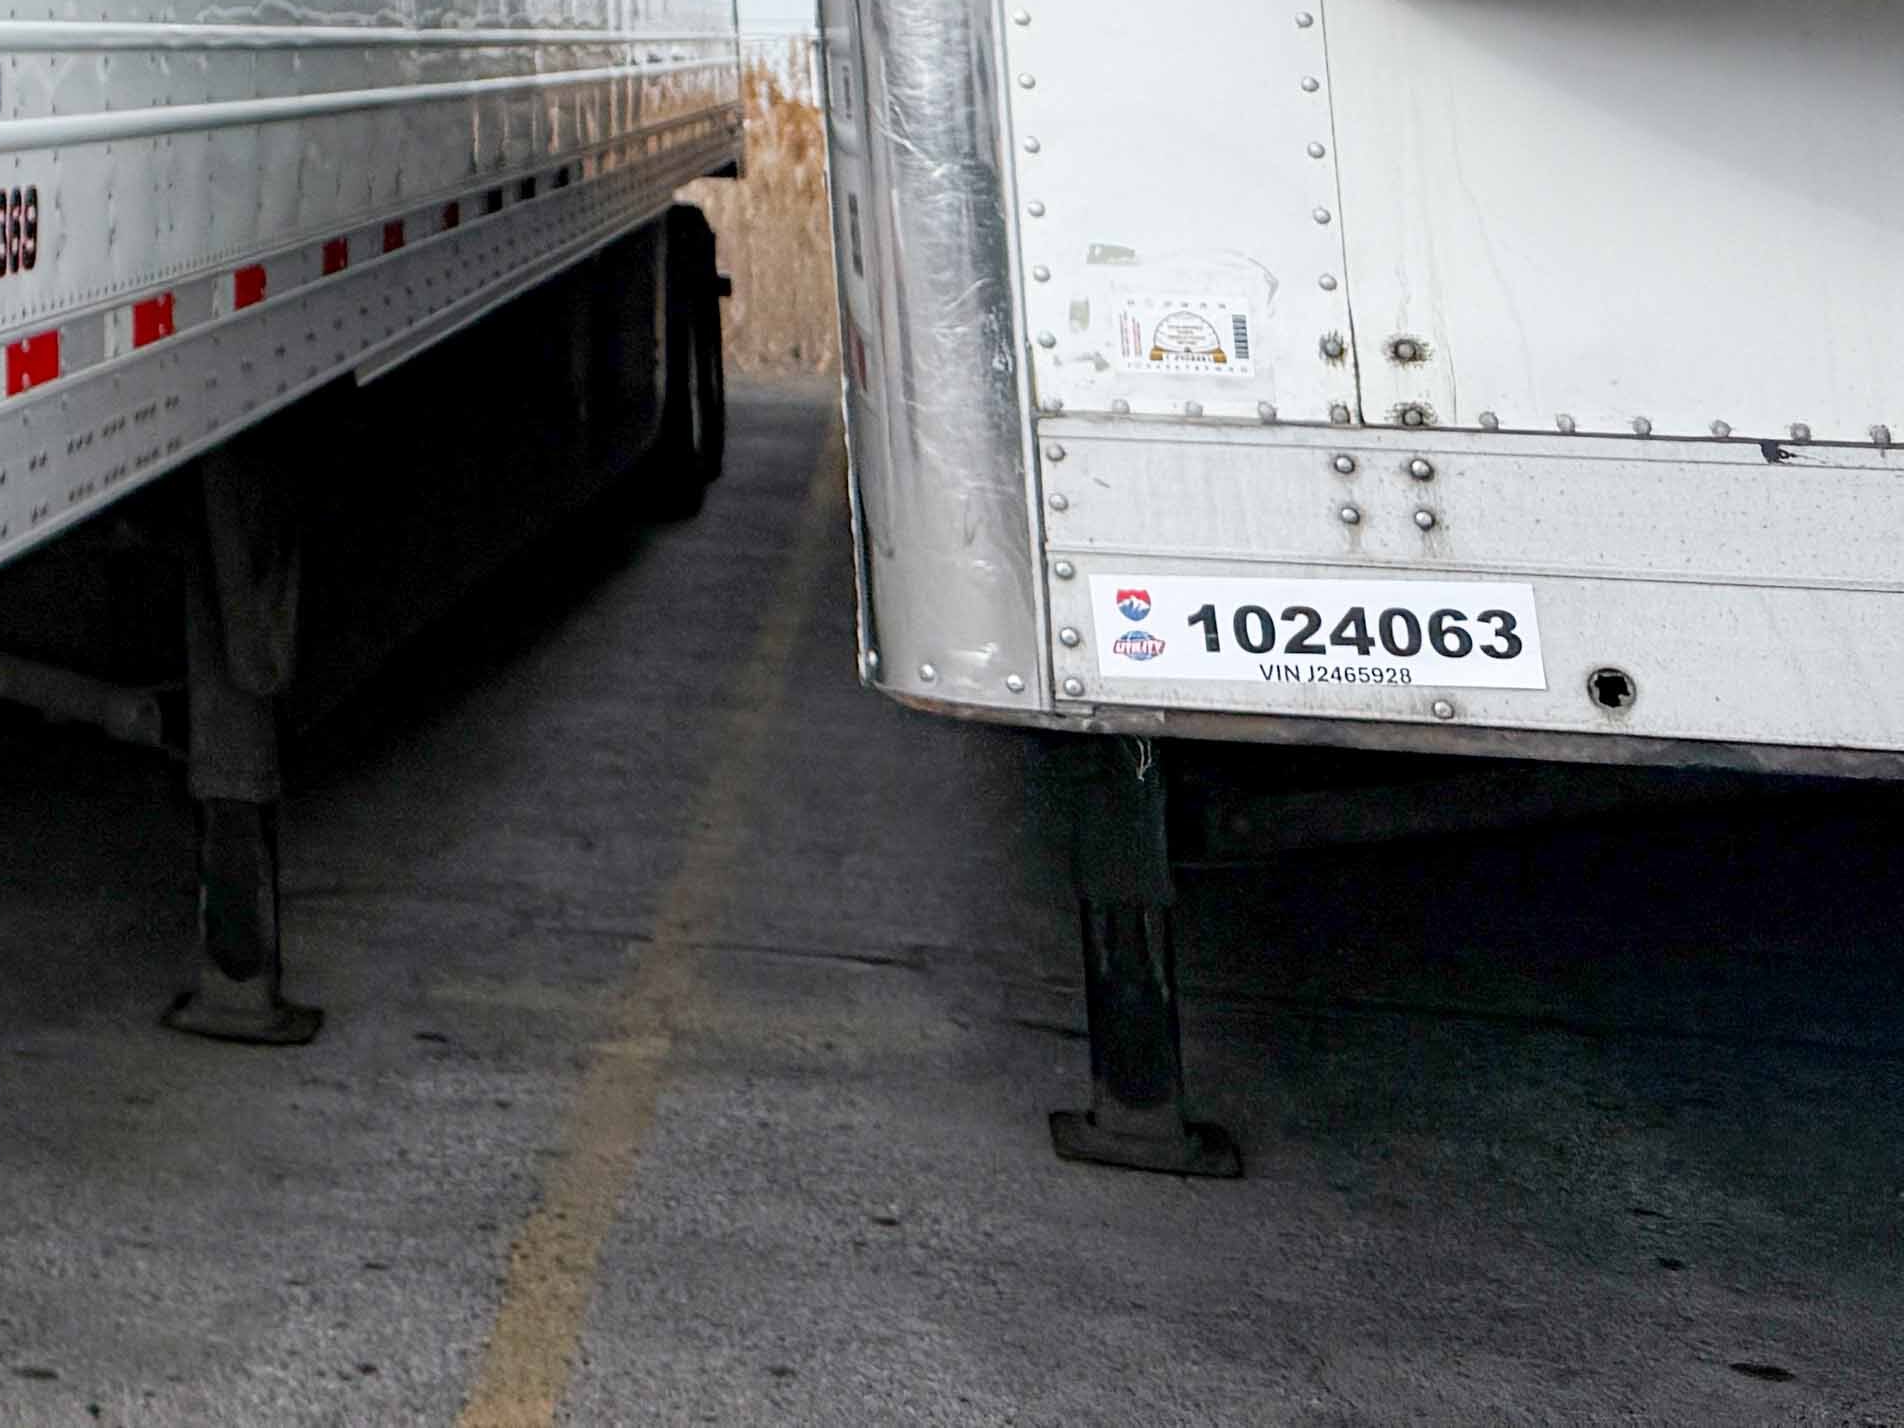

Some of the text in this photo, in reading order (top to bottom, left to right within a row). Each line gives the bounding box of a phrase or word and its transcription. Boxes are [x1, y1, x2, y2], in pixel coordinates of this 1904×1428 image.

[1187, 602, 1524, 661] 1024063
[1113, 638, 1165, 656] UTILITY
[1258, 662, 1413, 685] VIN J2465928
